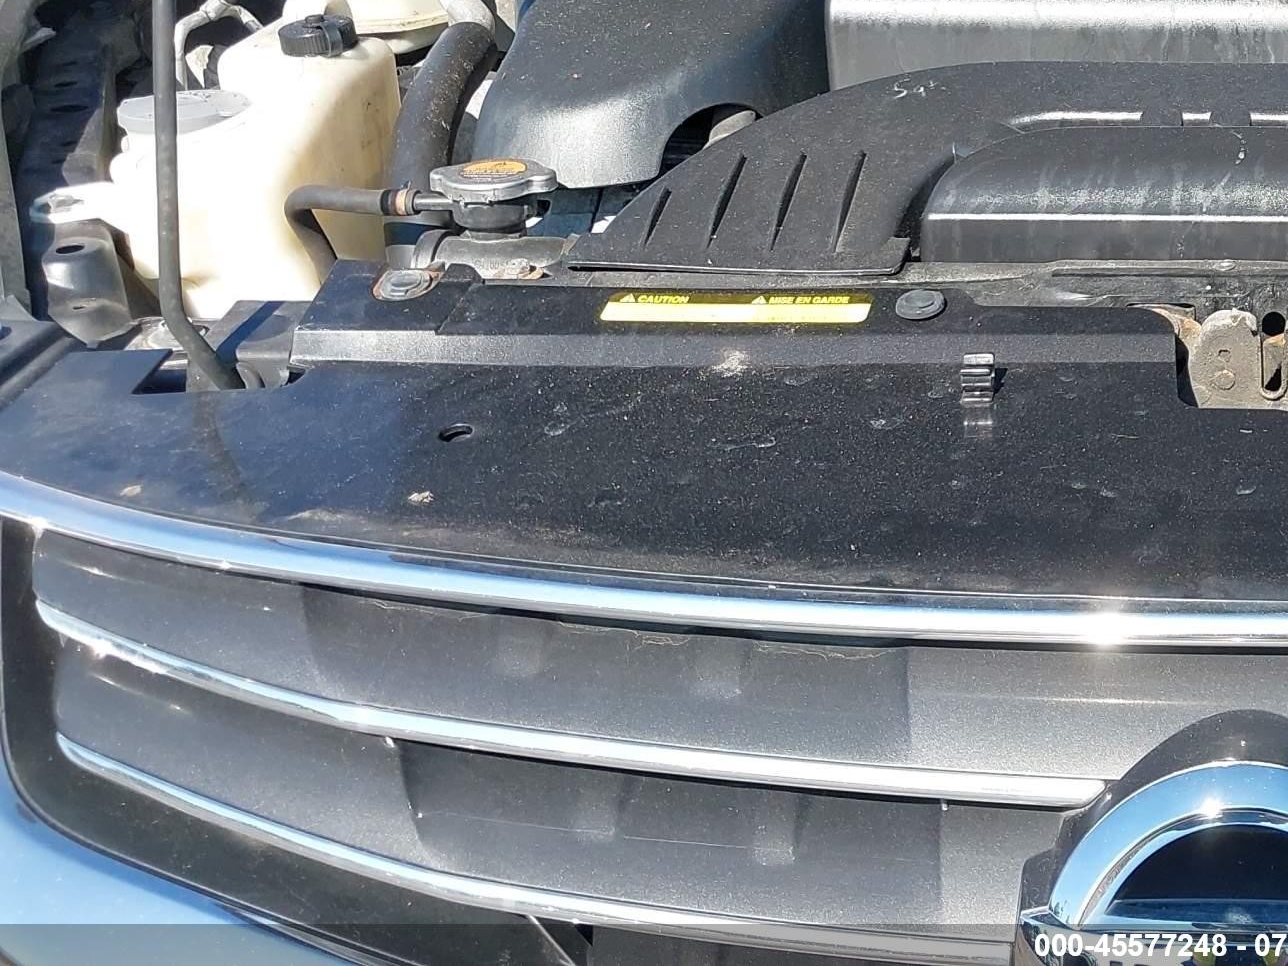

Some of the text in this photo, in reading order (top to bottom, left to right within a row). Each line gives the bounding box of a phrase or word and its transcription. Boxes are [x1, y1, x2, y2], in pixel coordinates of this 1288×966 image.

[637, 294, 690, 304] CAUTION
[768, 295, 851, 305] MISE EN GARDE
